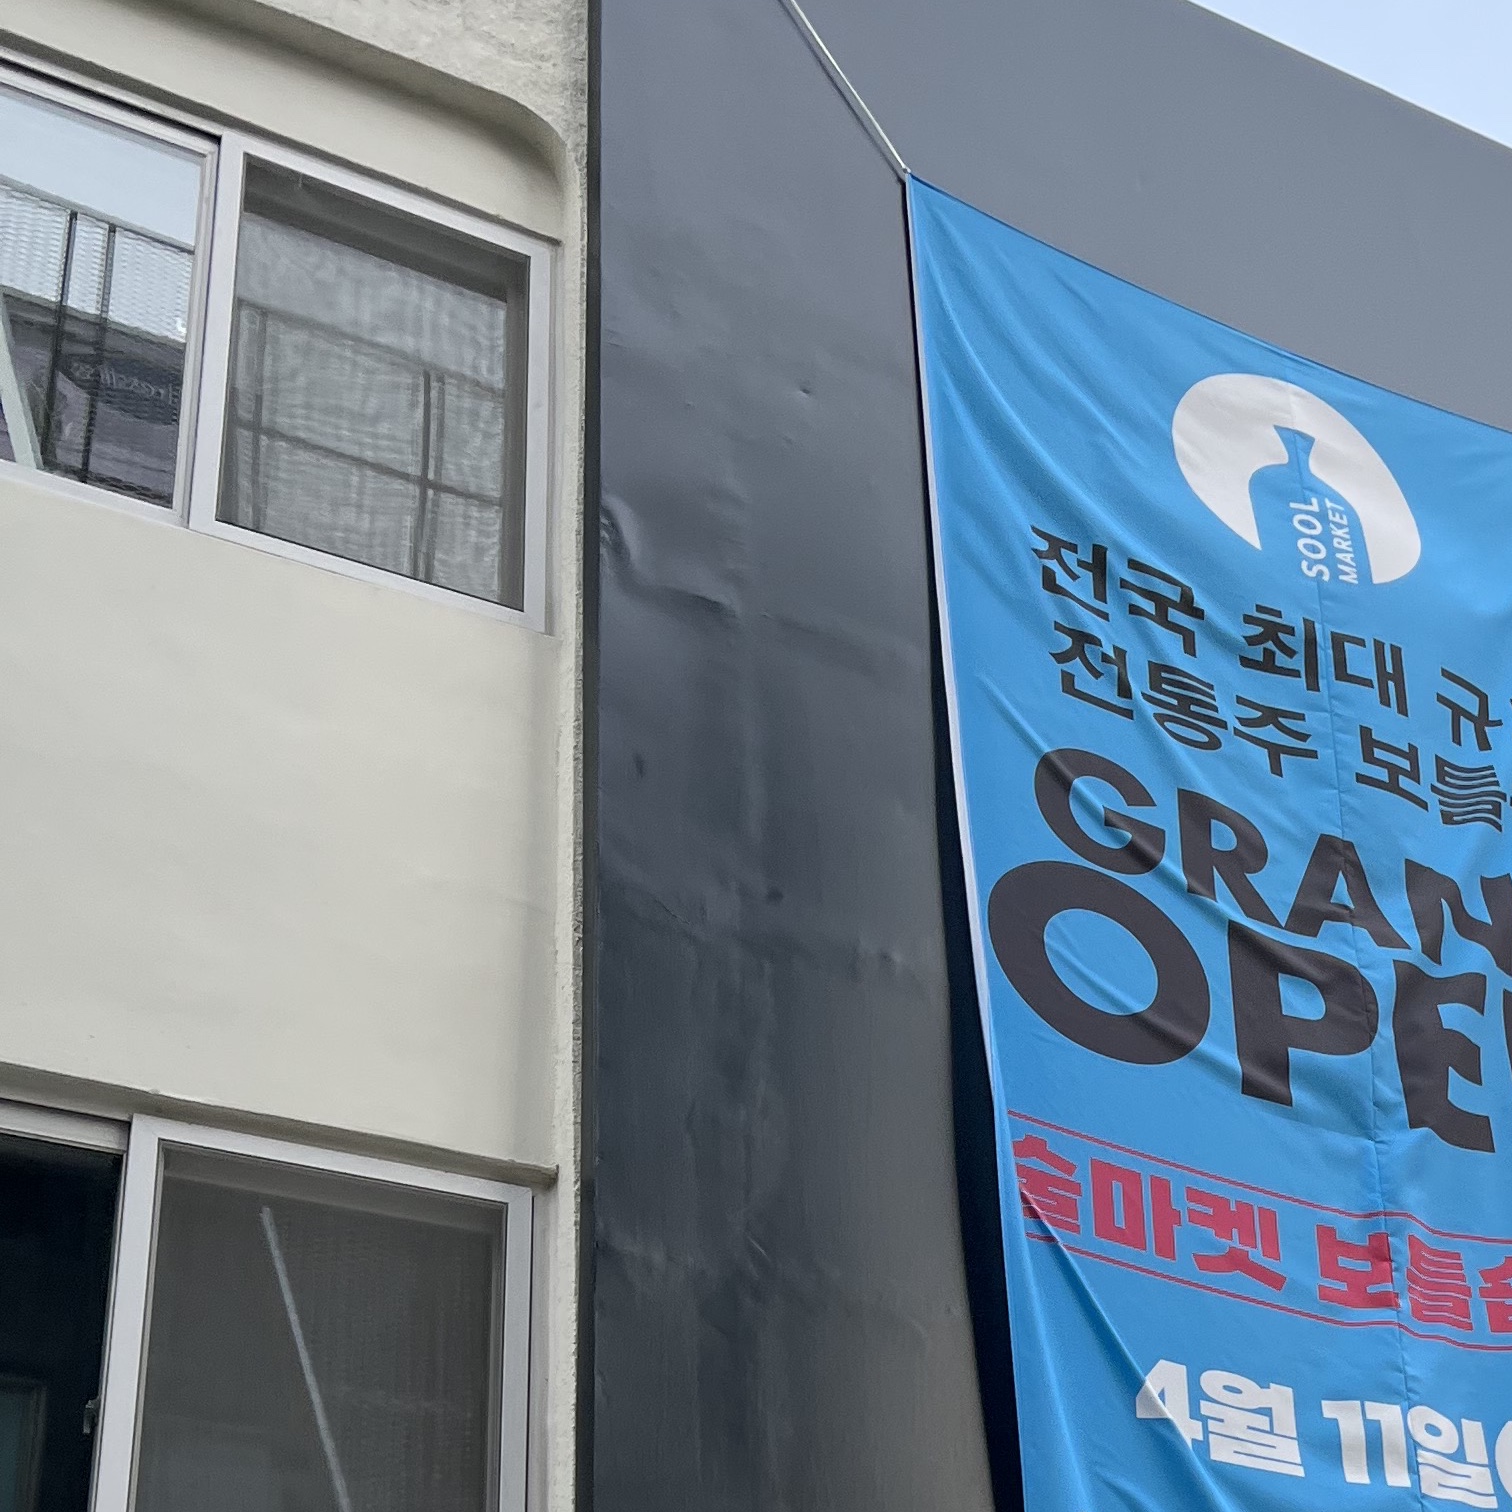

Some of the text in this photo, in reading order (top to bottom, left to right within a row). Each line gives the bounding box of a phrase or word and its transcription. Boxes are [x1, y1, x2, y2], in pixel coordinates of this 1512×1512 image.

[1289, 496, 1331, 582] SOOL
[1322, 498, 1361, 584] MARKET
[1029, 524, 1205, 659] 전국
[1238, 603, 1410, 717] 최대
[1049, 620, 1319, 779] 전통주
[1012, 1135, 1286, 1291] 술마켓
[1135, 1359, 1305, 1477] 4월
